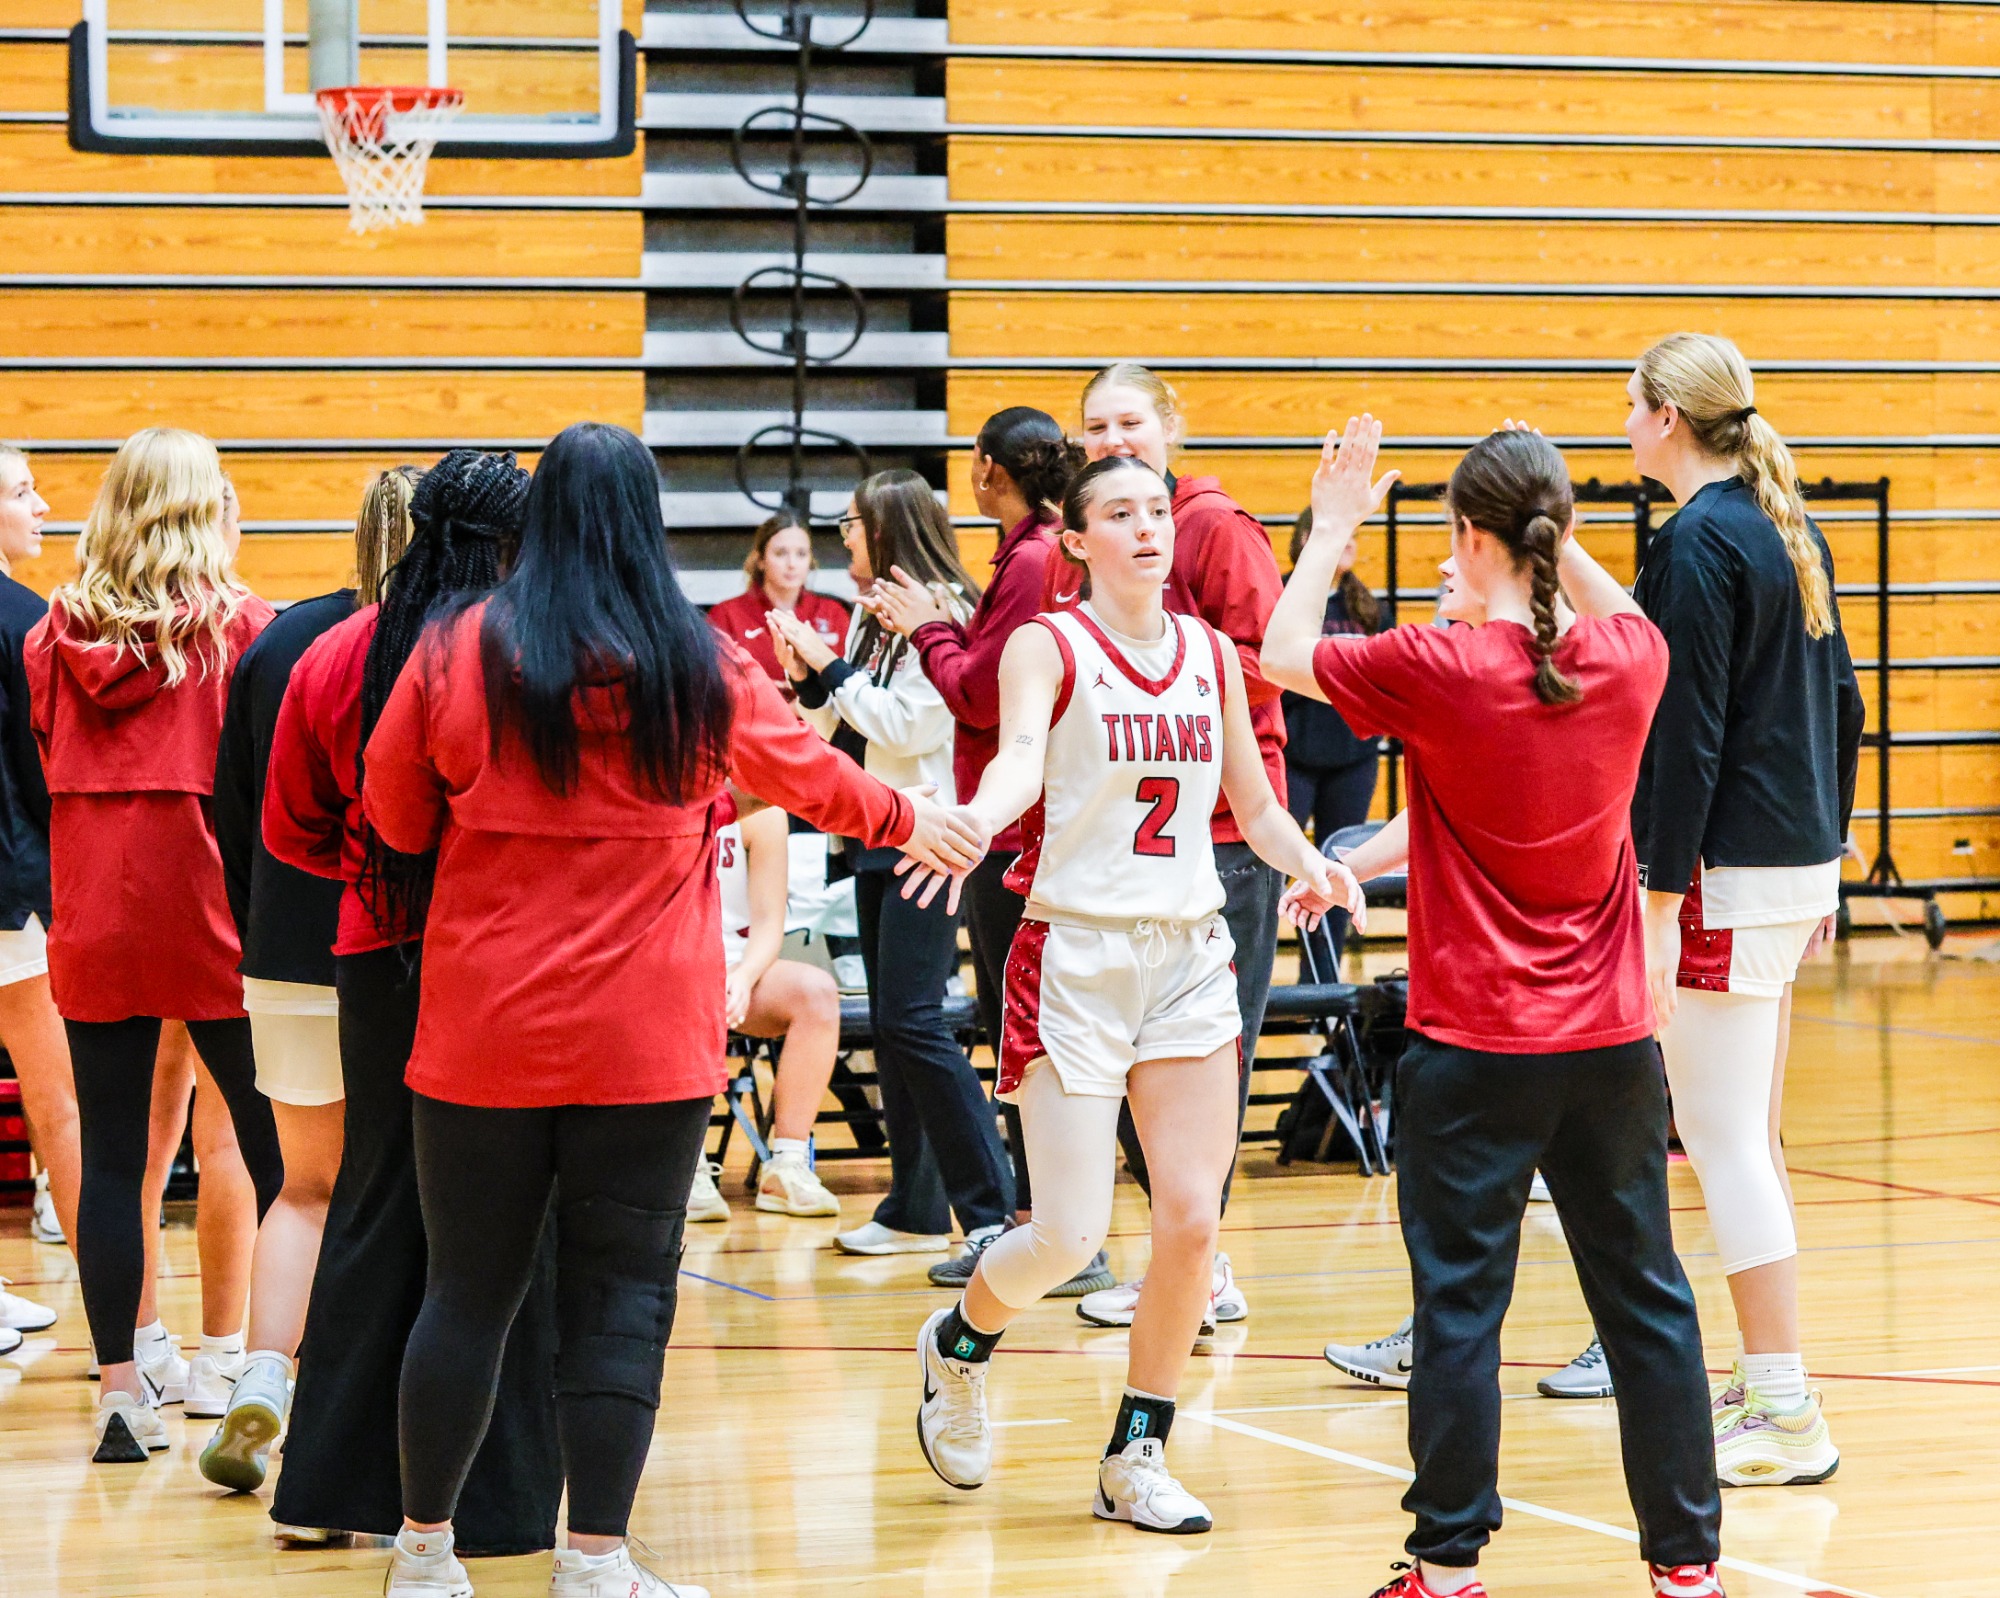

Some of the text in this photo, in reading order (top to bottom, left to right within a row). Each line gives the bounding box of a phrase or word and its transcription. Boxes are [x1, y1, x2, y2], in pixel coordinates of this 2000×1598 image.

[1015, 734, 1034, 746] 222
[1101, 713, 1213, 763] TITANS
[1133, 776, 1180, 858] 2
